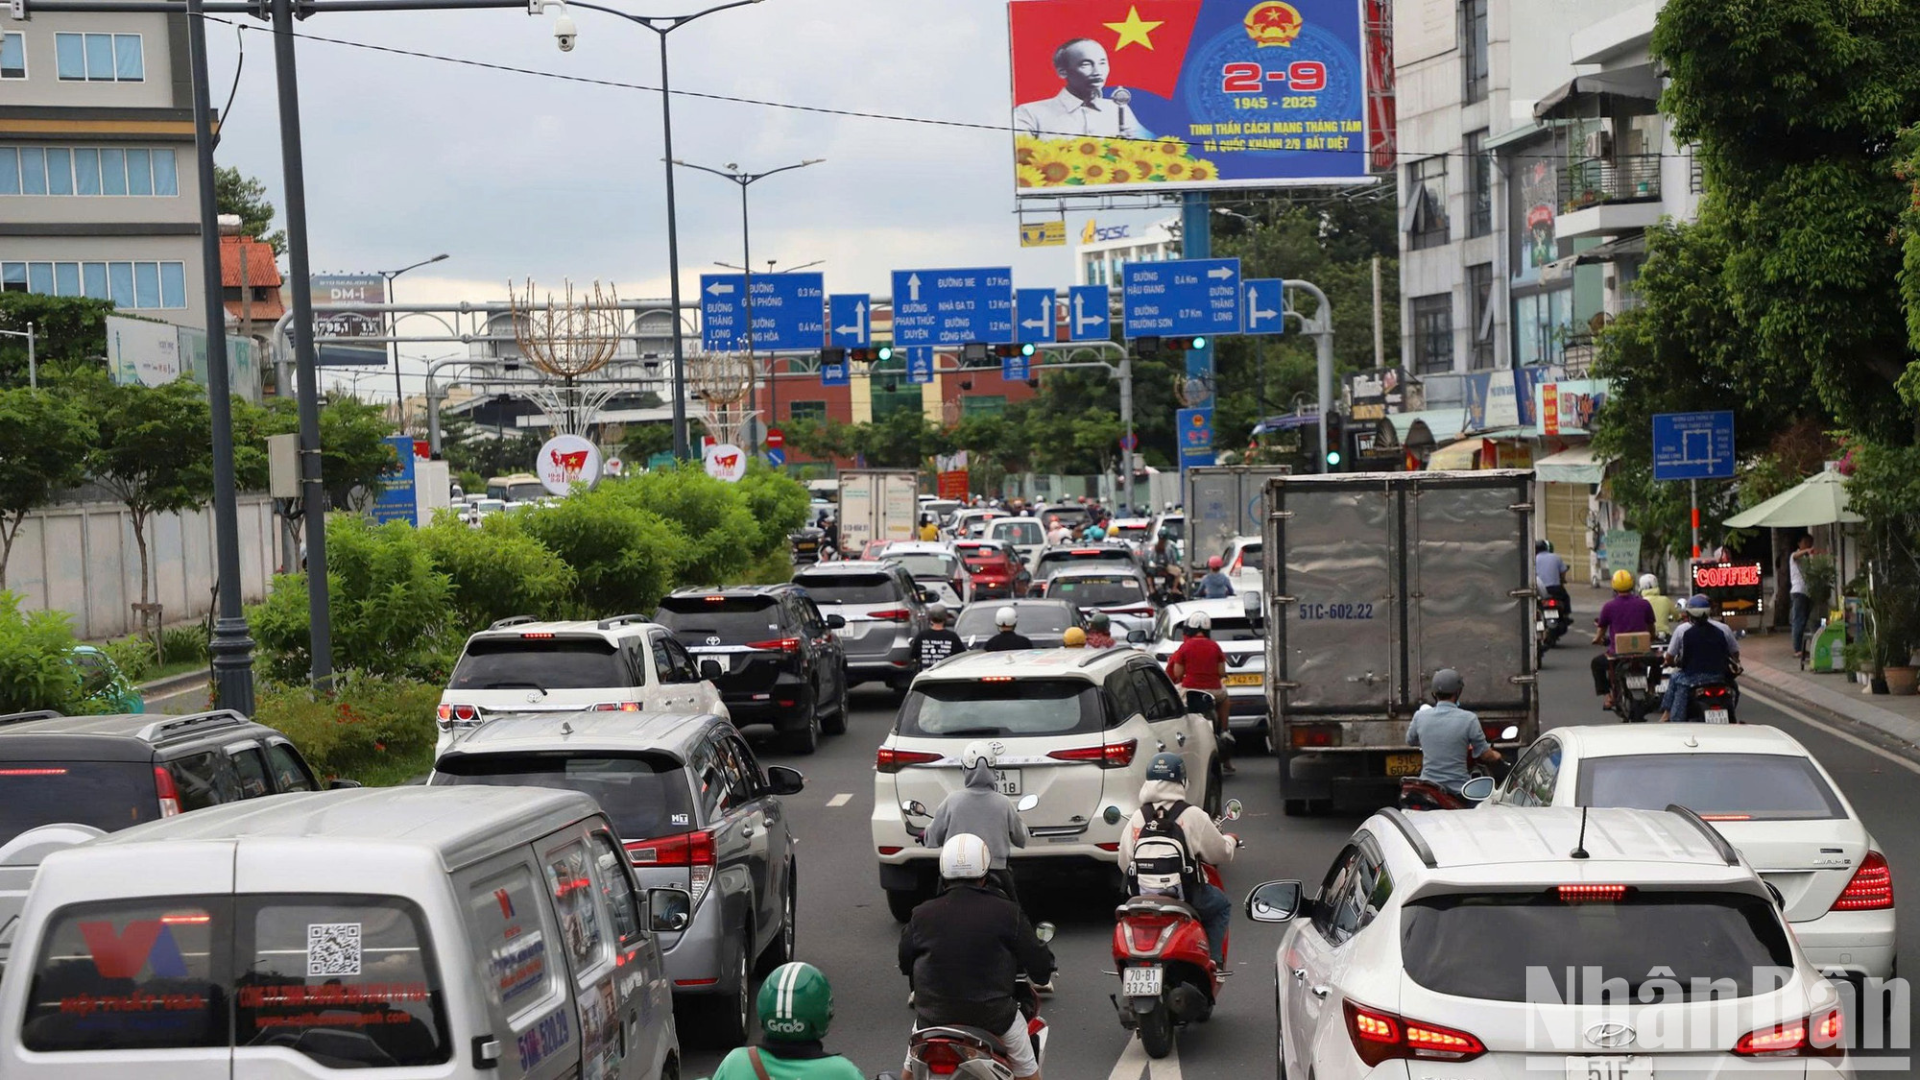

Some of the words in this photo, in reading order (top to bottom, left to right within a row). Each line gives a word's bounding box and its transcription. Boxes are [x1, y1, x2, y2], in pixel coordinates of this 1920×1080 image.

[1222, 60, 1327, 93] 2-9
[1234, 97, 1268, 109] 1945
[1282, 96, 1317, 108] 2025
[1244, 120, 1270, 134] CÁCH
[1274, 121, 1302, 136] MẠNG
[1305, 119, 1338, 132] THÁNG
[1341, 118, 1362, 132] TÁM
[1327, 134, 1348, 152] DIỆT
[1098, 225, 1130, 242] SCSC
[998, 278, 1010, 286] Km
[1185, 276, 1198, 284] Km
[809, 288, 822, 297] Km
[998, 300, 1010, 308] Km
[1190, 310, 1202, 318] Km
[1213, 312, 1233, 321] LONG
[810, 323, 822, 331] Km
[999, 322, 1011, 330] Km
[710, 330, 731, 339] LONG
[1696, 566, 1759, 587] COFFEE
[1300, 604, 1373, 619] 51C-602.22
[1130, 970, 1156, 981] 70-B1
[768, 1019, 805, 1033] Grab
